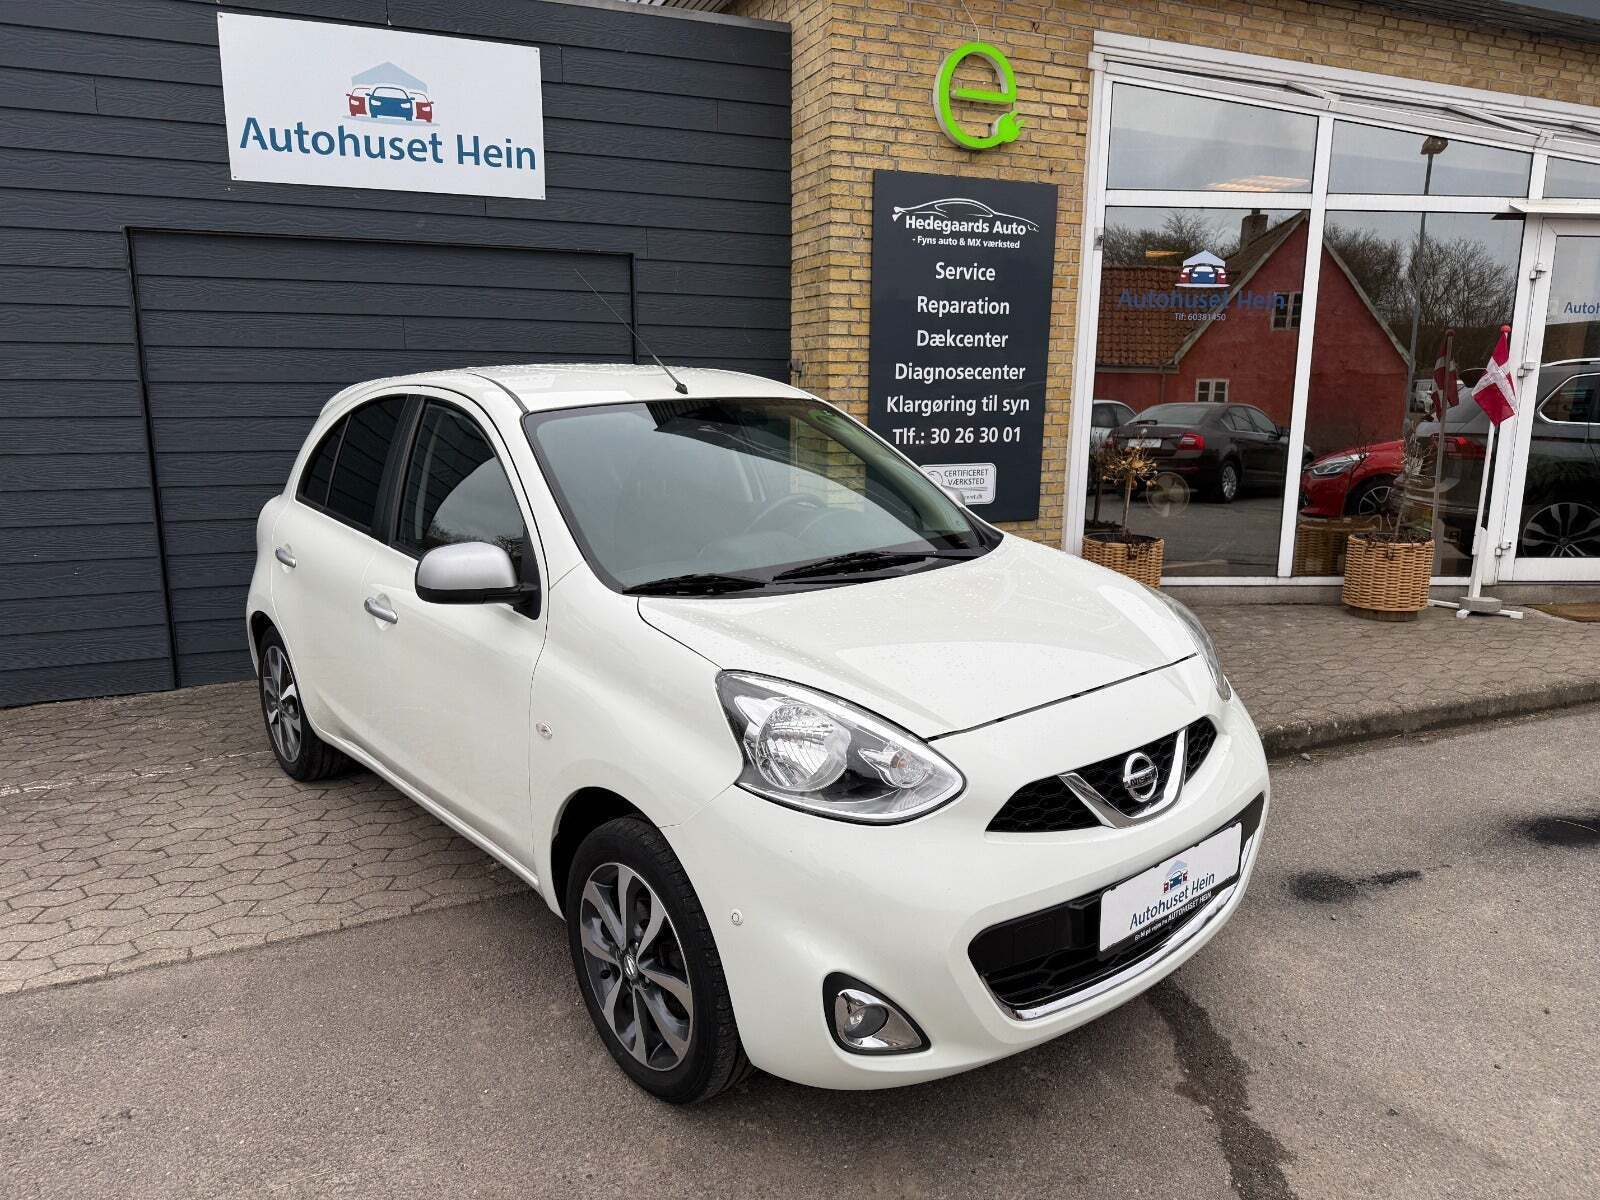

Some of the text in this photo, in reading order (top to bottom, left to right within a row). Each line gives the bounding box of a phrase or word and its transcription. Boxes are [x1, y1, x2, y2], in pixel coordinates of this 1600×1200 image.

[239, 116, 536, 170] Autohuset Hein
[905, 215, 1027, 236] Hedegaards Auto
[917, 235, 937, 246] Fyns
[938, 237, 958, 246] auto
[959, 237, 966, 246] &
[967, 238, 982, 247] MX
[983, 238, 1020, 249] værksted
[935, 261, 996, 281] Service
[917, 295, 1010, 317] Reparation
[1119, 288, 1229, 310] Autohuset
[916, 329, 1009, 348] Dækcenter
[895, 362, 1026, 384] Diagnosecenter
[886, 395, 1030, 416] Klargøring til syn
[893, 426, 1021, 445] Tlf.: 30 26 30 01
[944, 468, 988, 478] CERTIFICERET
[947, 478, 985, 486] VÆRKSTED
[1130, 885, 1189, 930] Autohuset
[1191, 872, 1215, 895] Hein
